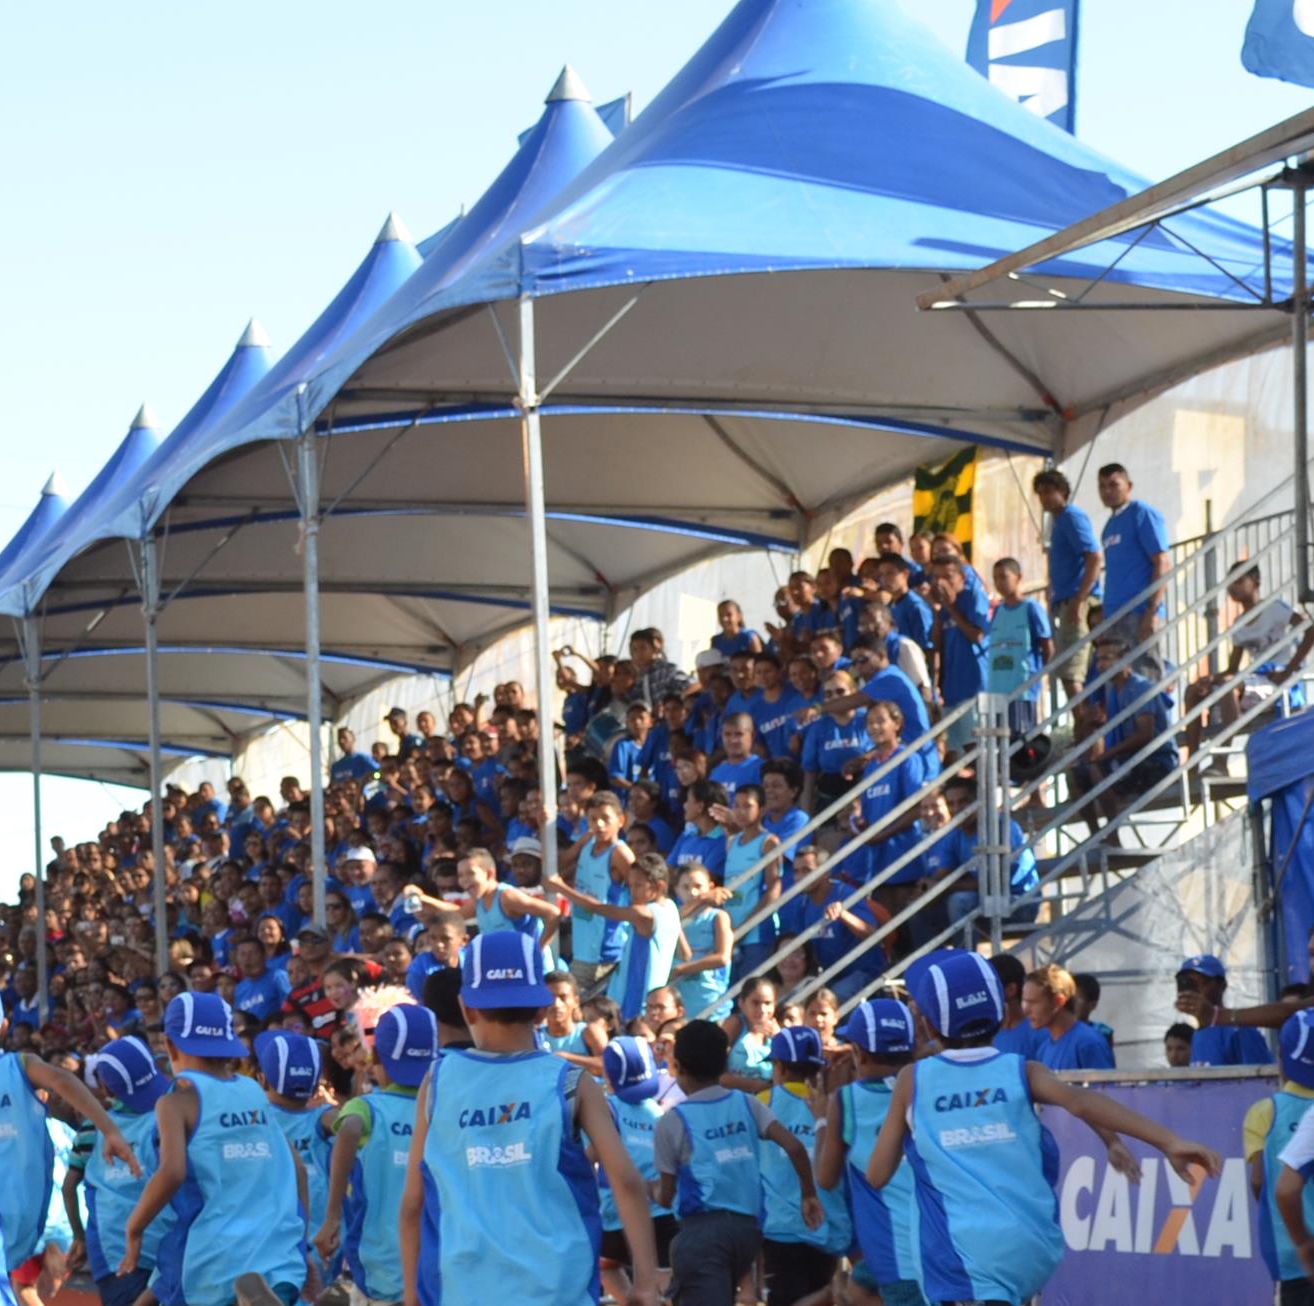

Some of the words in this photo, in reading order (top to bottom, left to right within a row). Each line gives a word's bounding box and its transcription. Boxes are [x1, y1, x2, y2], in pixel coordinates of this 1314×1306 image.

[487, 968, 523, 980] CAIXA
[934, 1087, 1008, 1112] CAIXA
[459, 1102, 531, 1129] CAIXA
[940, 1122, 1016, 1147] BRASIL
[466, 1142, 532, 1167] BRASIL
[1059, 1155, 1253, 1259] CAIXA
